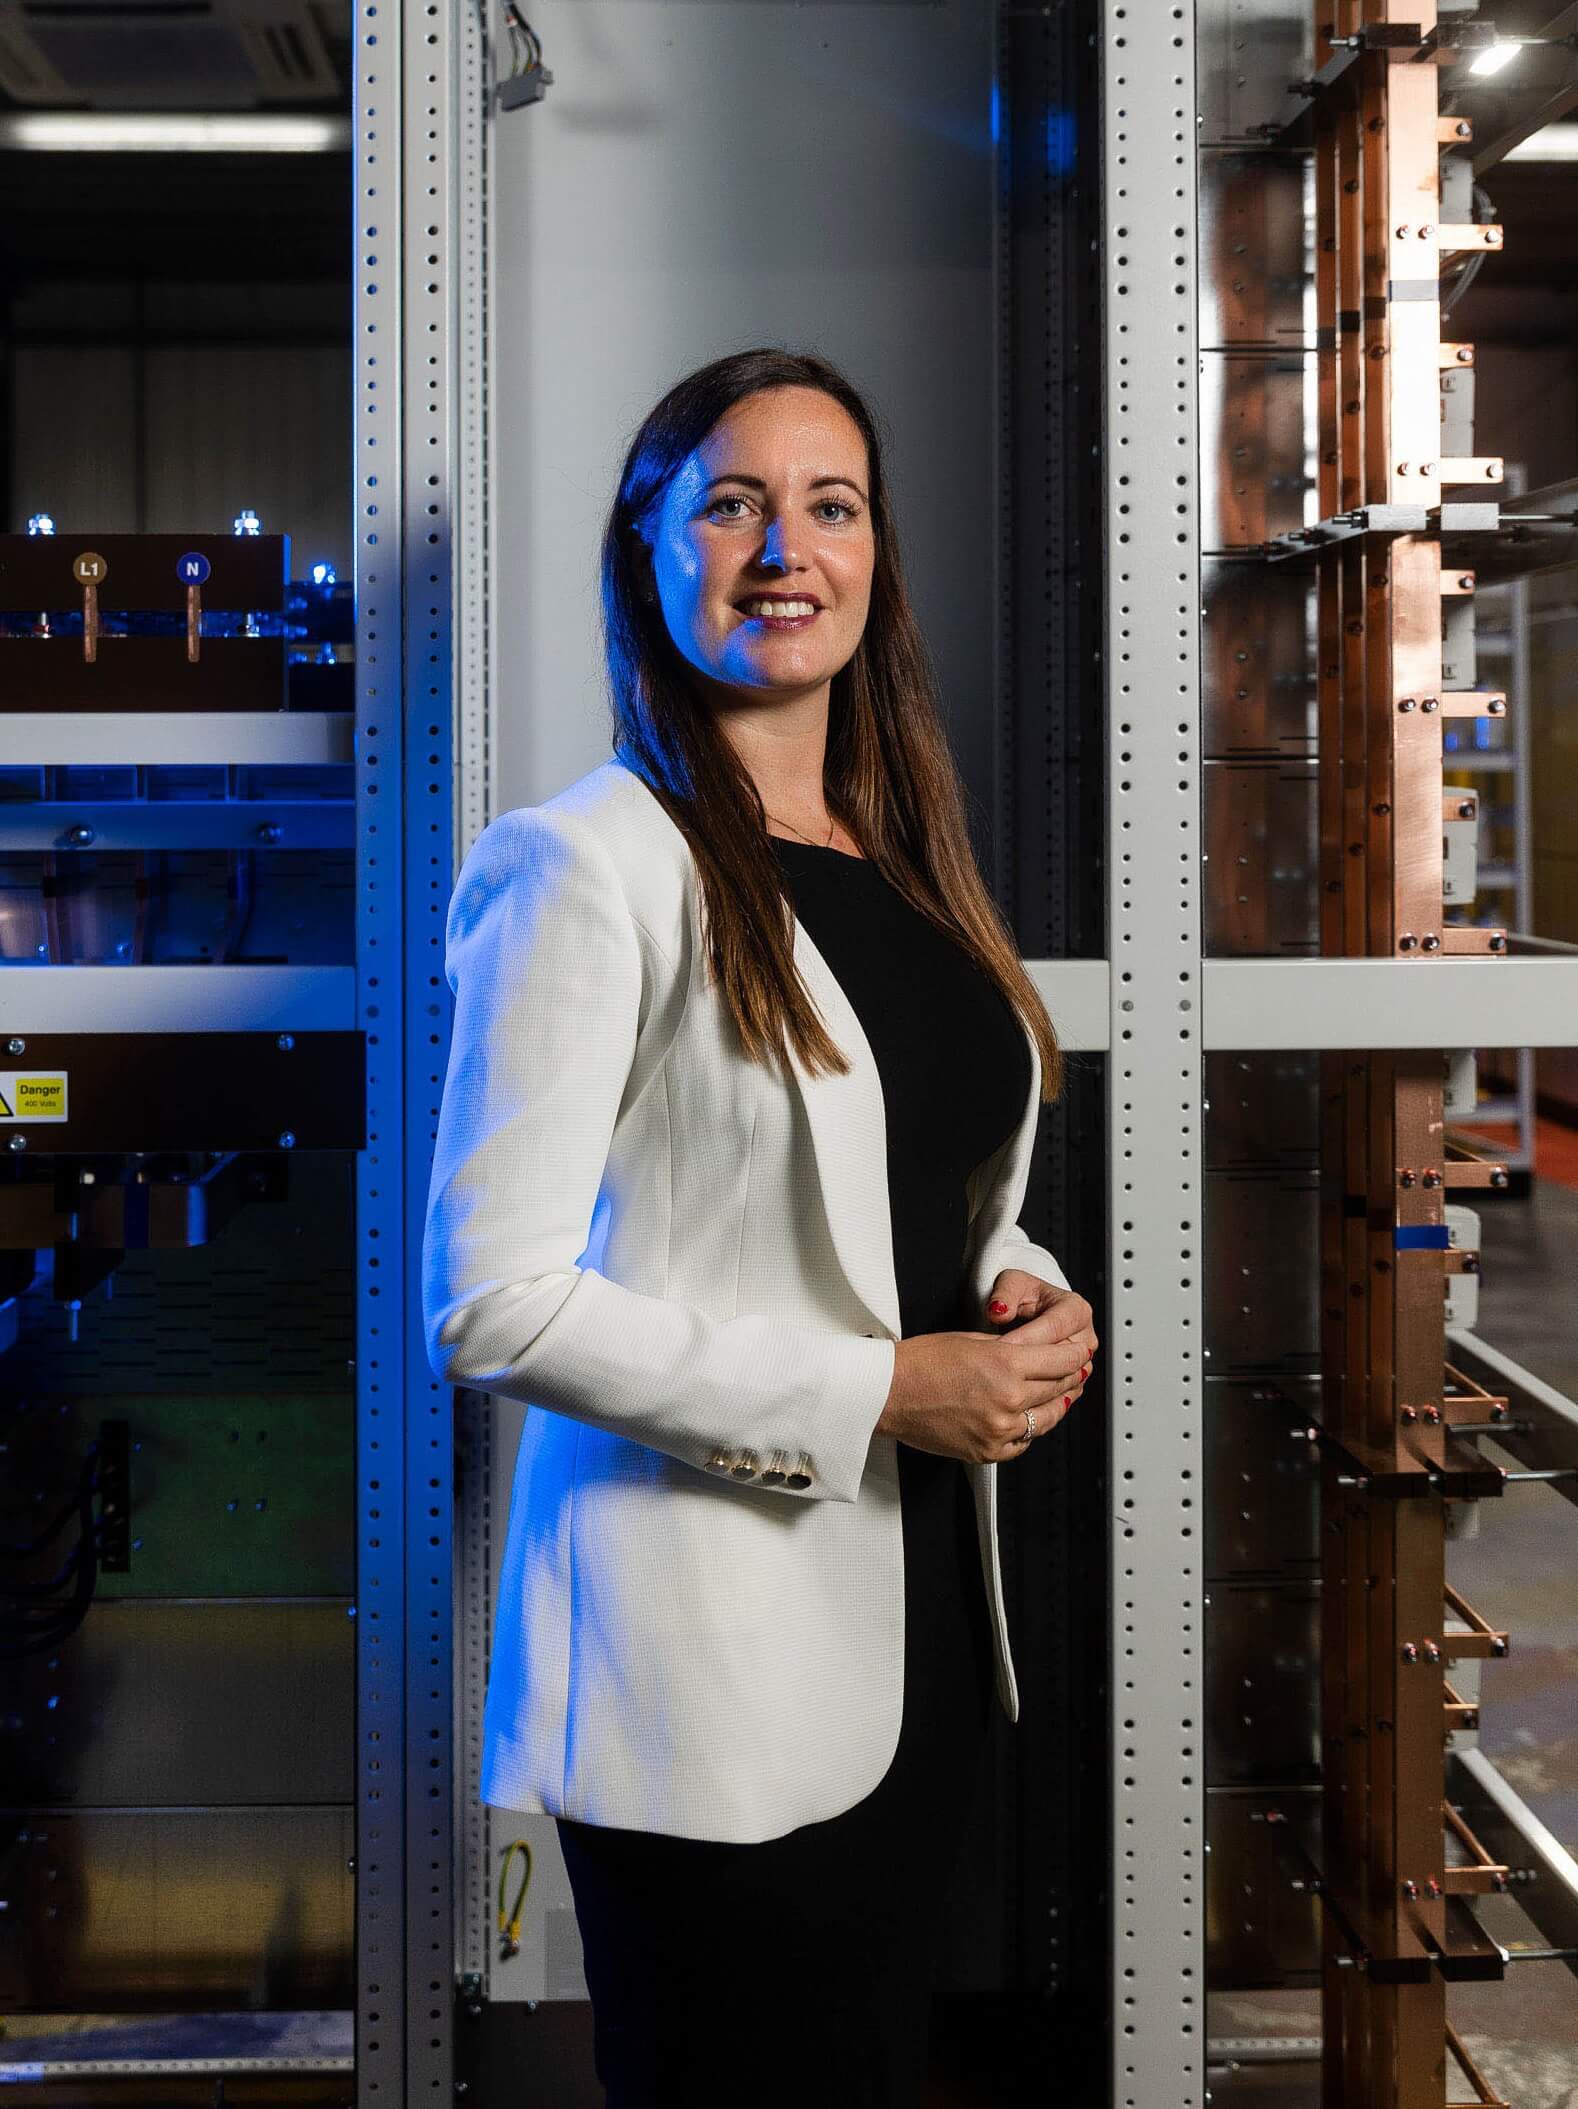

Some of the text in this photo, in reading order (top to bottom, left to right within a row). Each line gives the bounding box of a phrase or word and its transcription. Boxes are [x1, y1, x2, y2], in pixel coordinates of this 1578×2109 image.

[80, 562, 98, 576] L1
[186, 562, 199, 576] N
[20, 1085, 61, 1097] Danger
